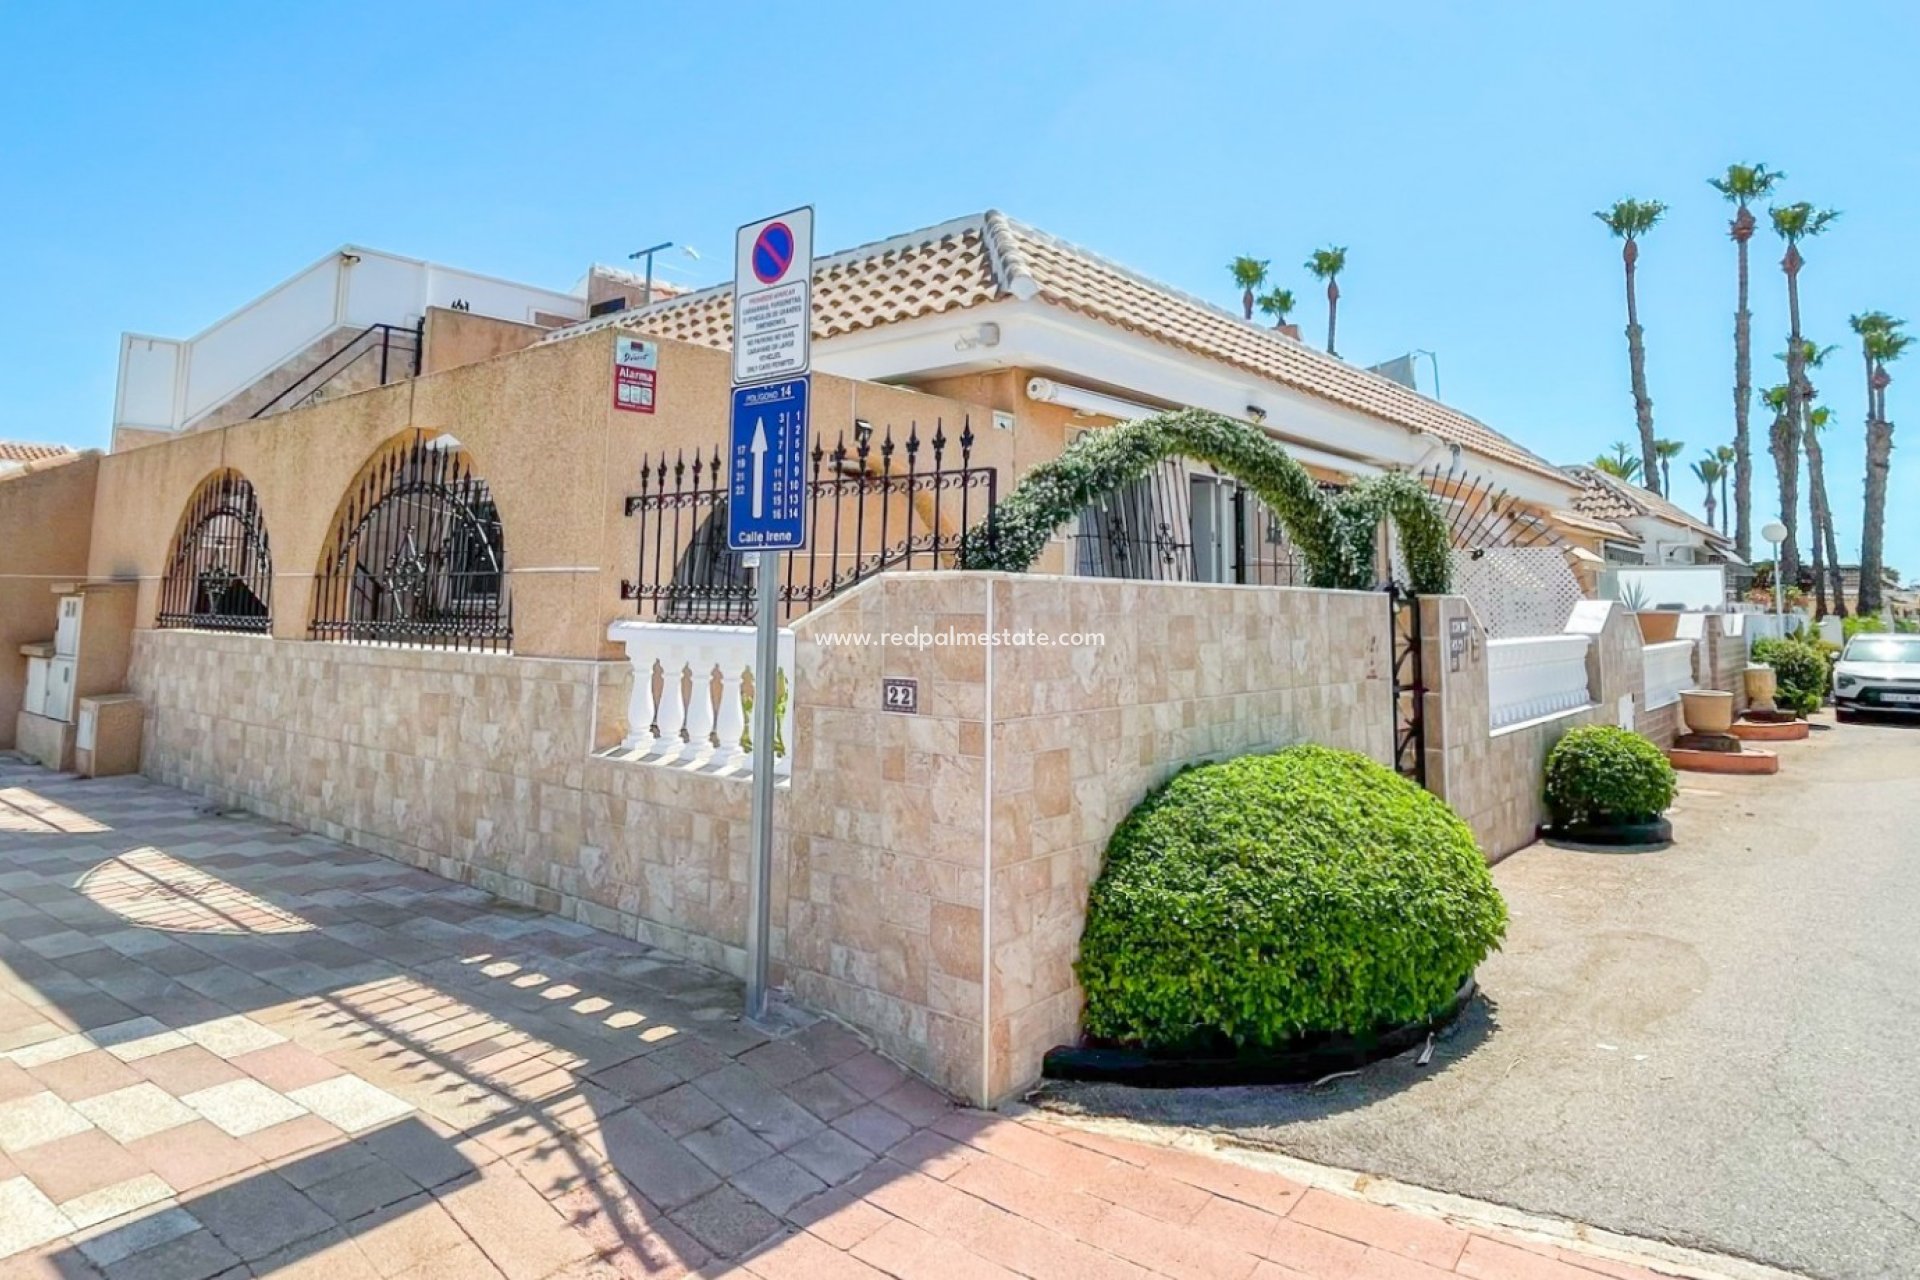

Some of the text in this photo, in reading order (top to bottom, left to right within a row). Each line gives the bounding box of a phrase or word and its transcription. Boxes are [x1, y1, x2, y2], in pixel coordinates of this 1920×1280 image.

[619, 366, 654, 382] Alarma
[781, 385, 792, 398] 14
[779, 412, 785, 423] 3
[796, 410, 800, 421] 1
[795, 424, 801, 435] 2
[778, 440, 783, 450] 7
[794, 452, 800, 462] 6
[794, 466, 800, 477] 9
[773, 481, 782, 492] 12
[790, 479, 800, 491] 10
[789, 494, 799, 505] 13
[789, 507, 799, 519] 14
[739, 530, 792, 543] Calle Irene
[890, 686, 910, 704] 22
